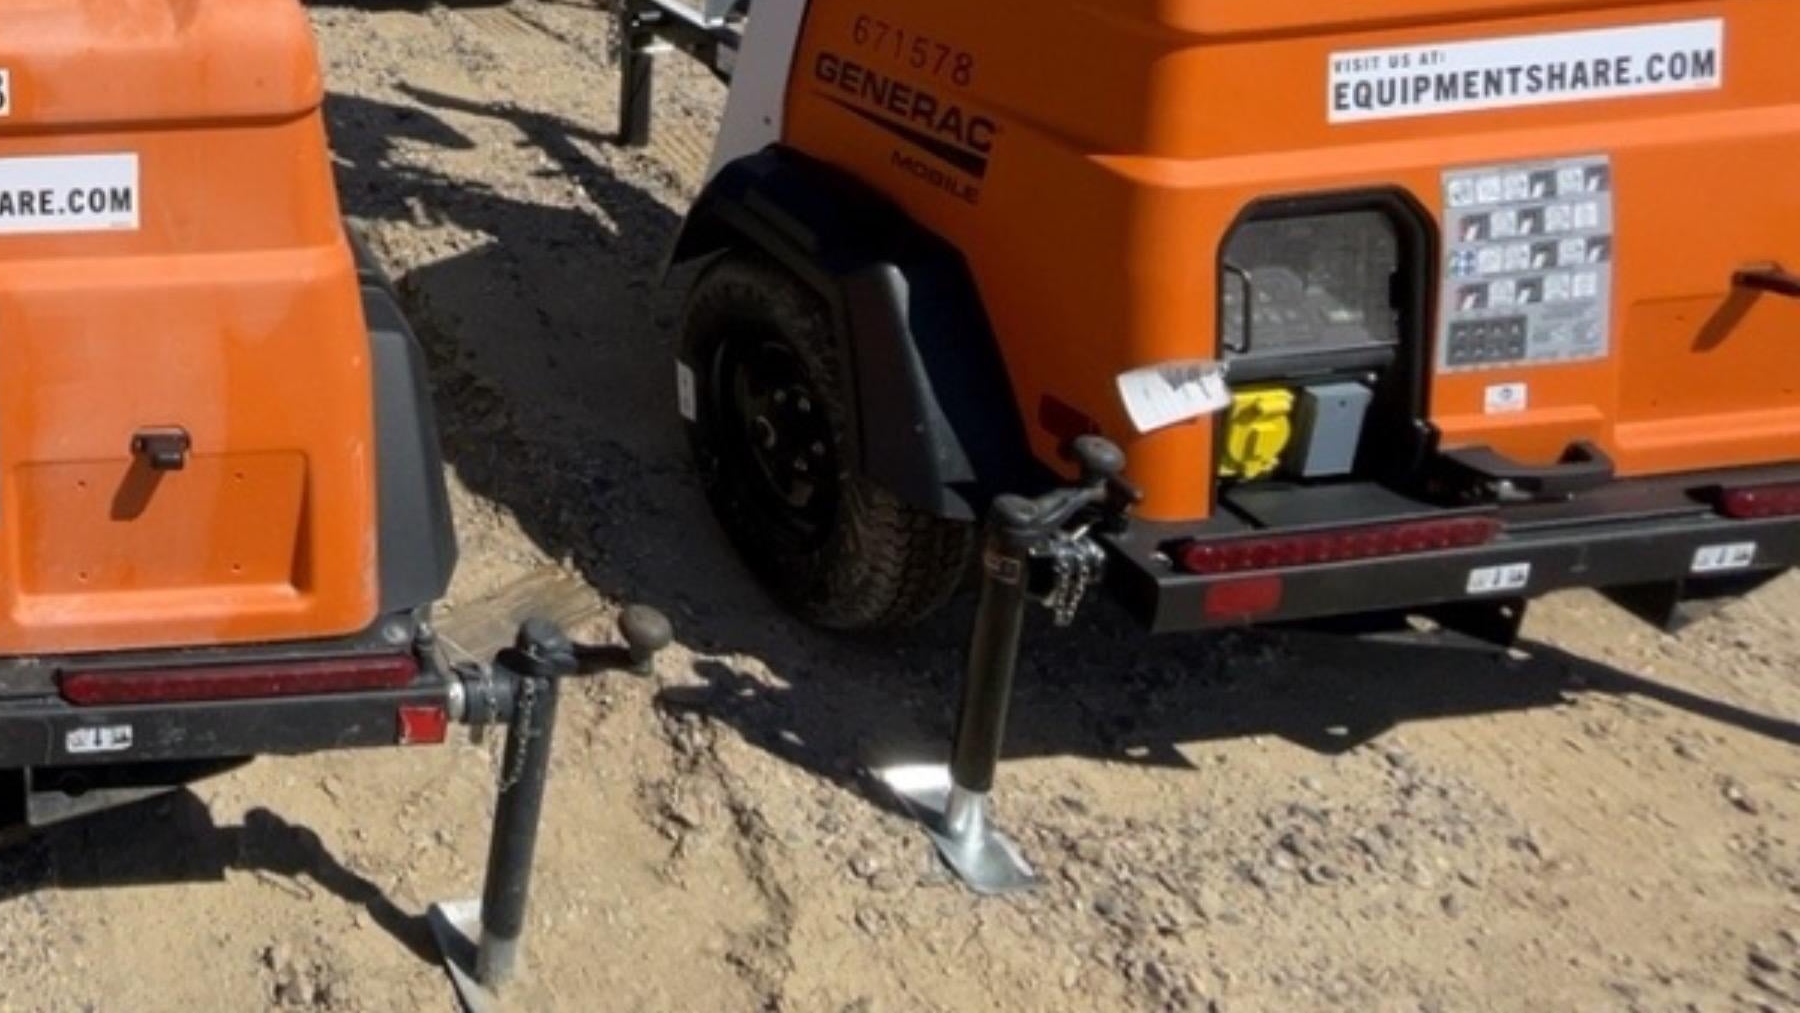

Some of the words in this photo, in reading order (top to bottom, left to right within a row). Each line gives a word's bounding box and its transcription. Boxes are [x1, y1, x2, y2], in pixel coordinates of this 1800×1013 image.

[853, 13, 974, 86] 671578
[1334, 55, 1380, 74] VISIT
[1388, 53, 1411, 69] US
[1334, 49, 1716, 111] EQUIPMENTSHARE.COM
[814, 51, 997, 153] GENERAC
[890, 150, 979, 207] MOBILE
